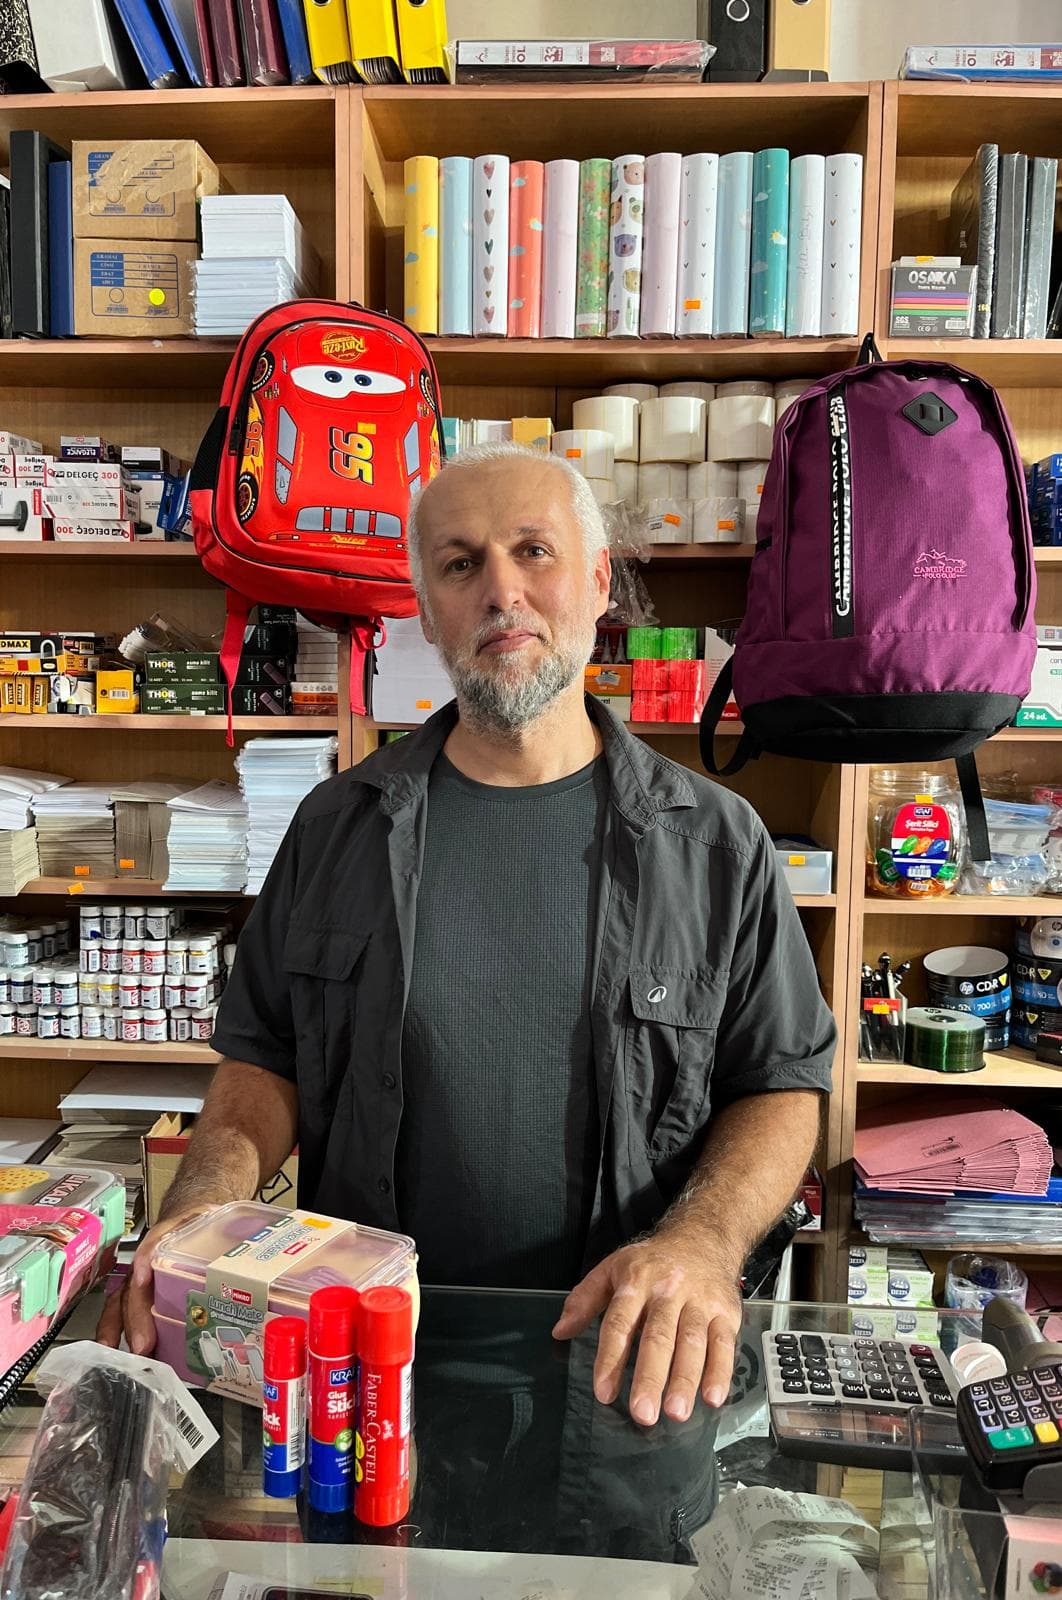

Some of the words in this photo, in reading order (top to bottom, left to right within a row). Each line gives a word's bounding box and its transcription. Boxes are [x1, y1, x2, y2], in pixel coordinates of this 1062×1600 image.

[908, 270, 956, 285] OSAKA
[329, 426, 374, 485] 95
[66, 471, 99, 481] DELGEÇ
[101, 472, 119, 480] 300
[56, 526, 74, 534] 300
[76, 524, 110, 536] DELGEÇ
[147, 660, 174, 668] THOR
[147, 689, 175, 698] THOR
[1023, 712, 1035, 720] 24
[208, 1295, 237, 1317] Lunch
[237, 1306, 264, 1323] Mate
[843, 1358, 852, 1366] 6
[846, 1370, 856, 1378] 9
[873, 1372, 882, 1380] 8
[788, 1380, 803, 1388] GT
[813, 1382, 831, 1390] MC
[327, 1391, 348, 1399] Glue
[1007, 1410, 1019, 1418] 9
[365, 1373, 382, 1484] FABER-CASTELL
